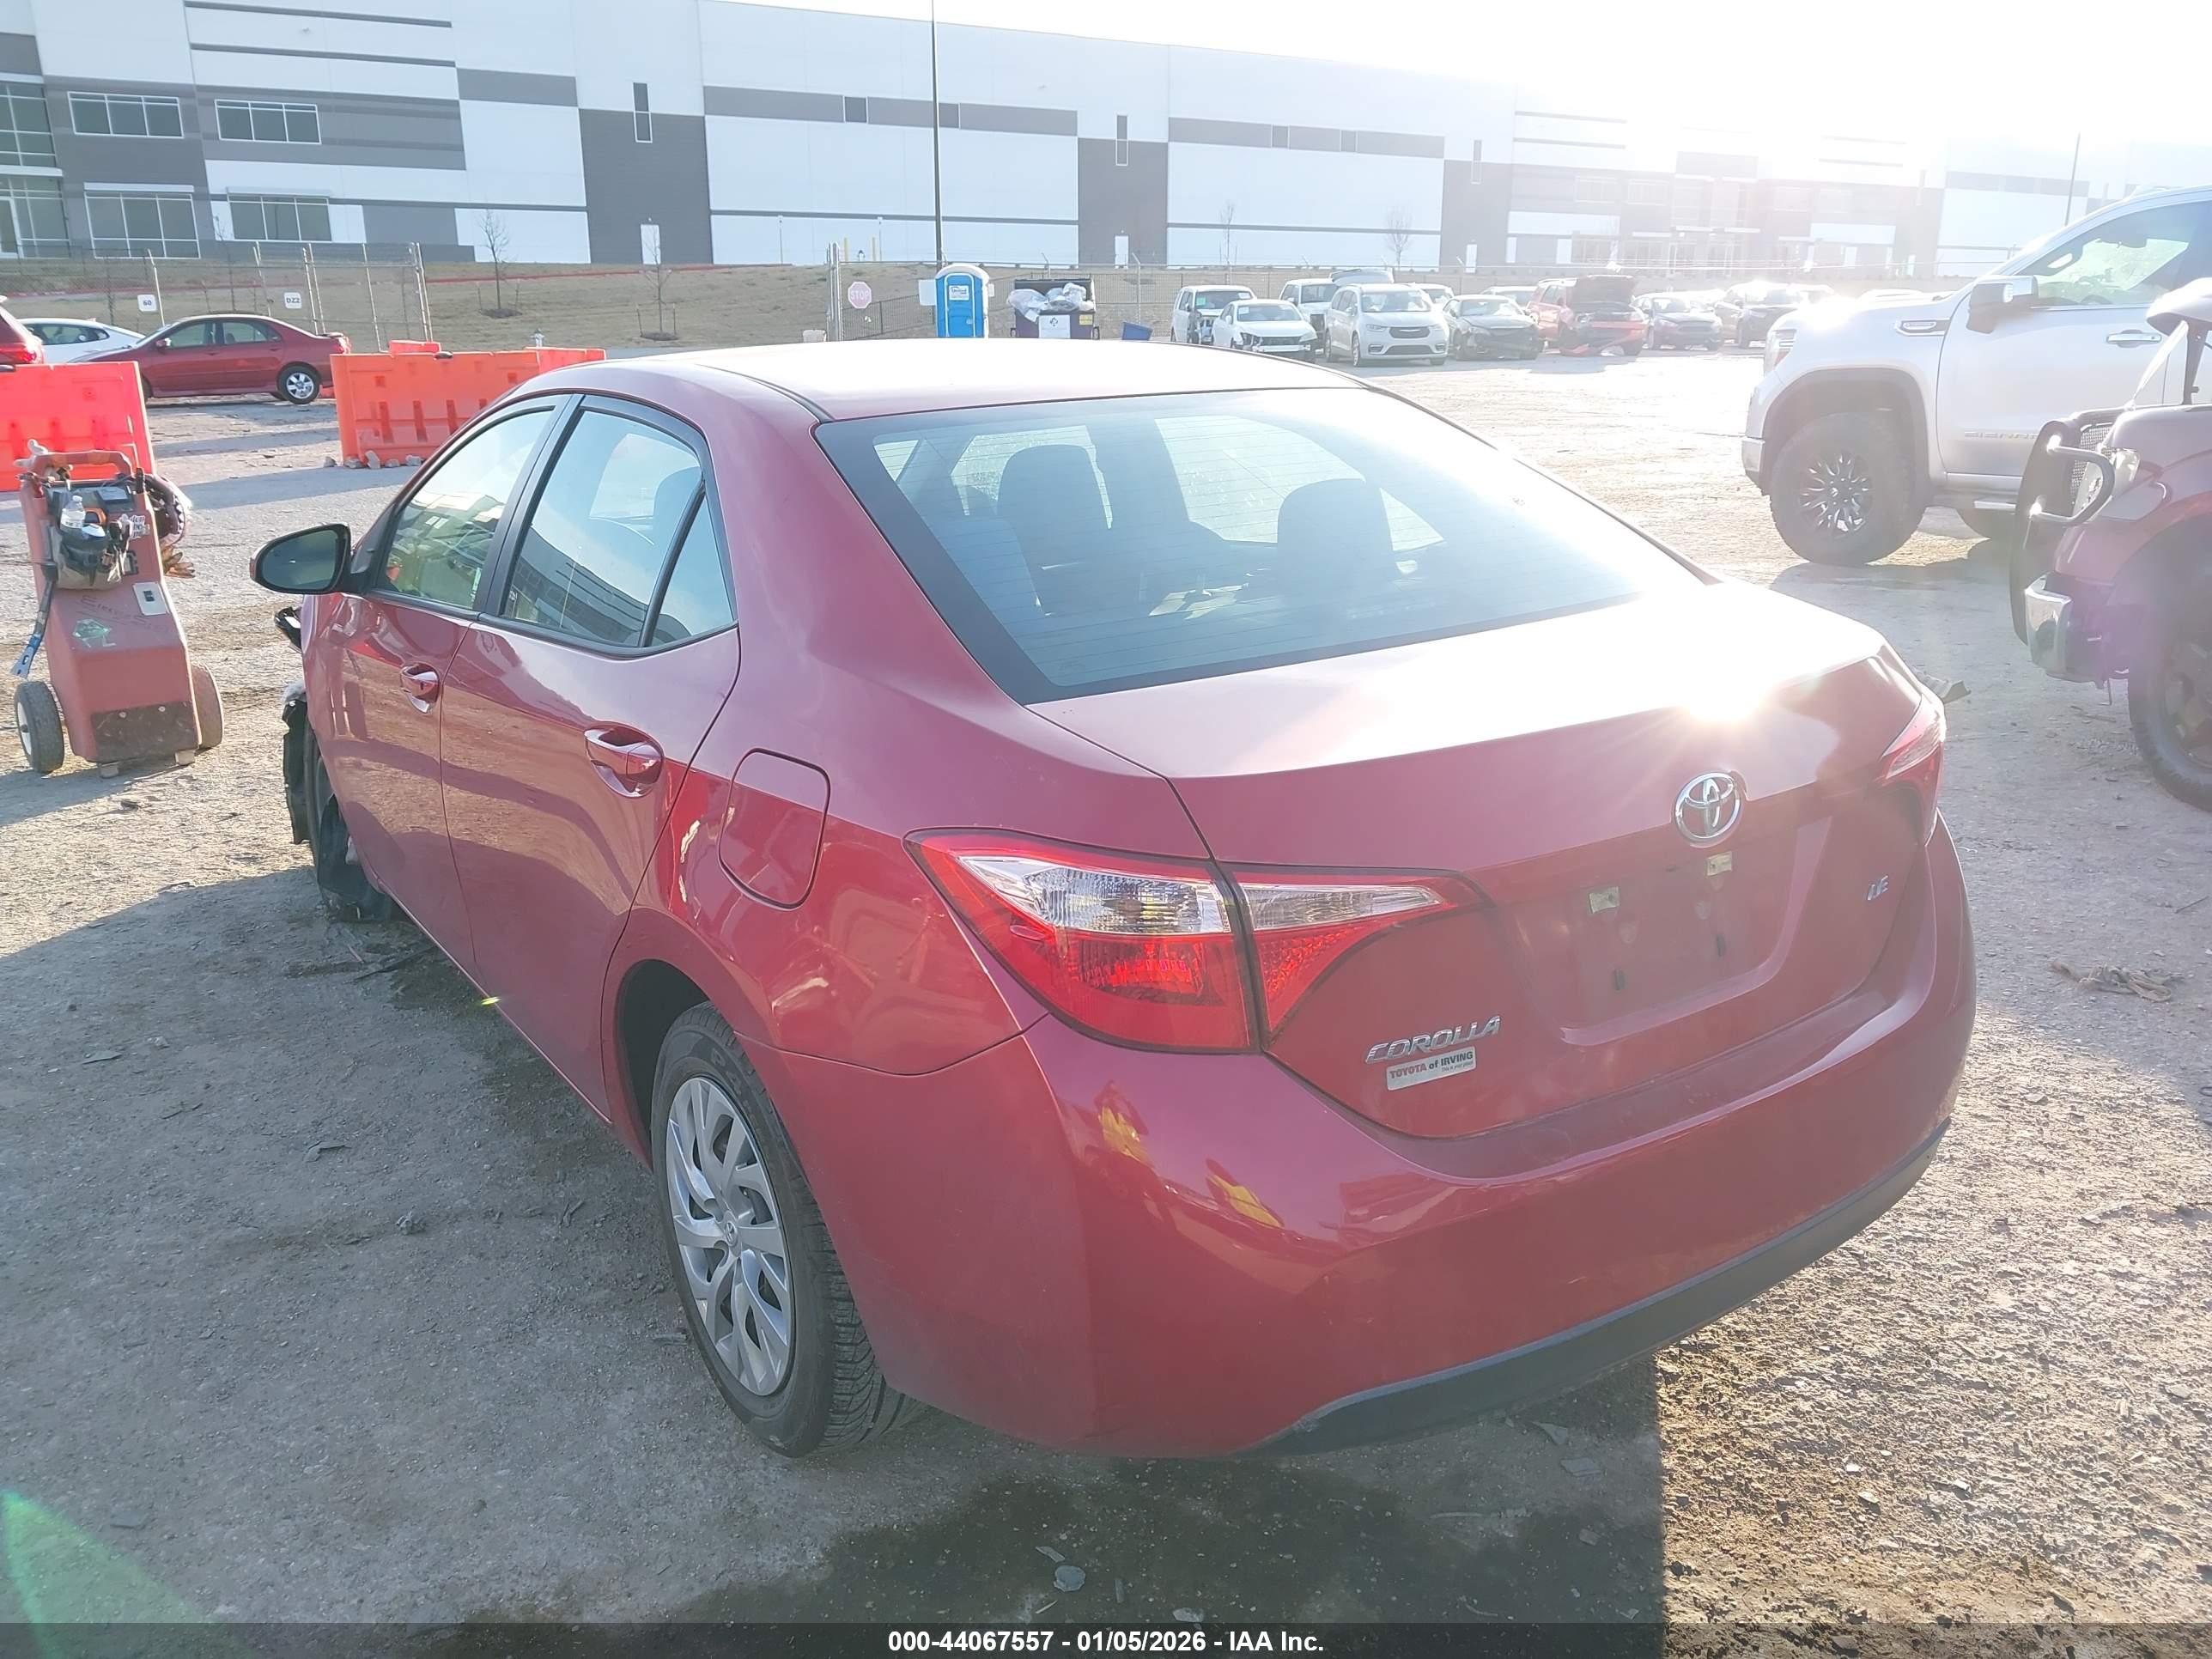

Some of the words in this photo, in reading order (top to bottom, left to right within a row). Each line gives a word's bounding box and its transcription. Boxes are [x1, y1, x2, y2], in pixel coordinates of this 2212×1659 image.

[851, 290, 870, 301] STOP
[1867, 874, 1888, 901] LE
[1365, 1015, 1501, 1065] COROLLA
[1389, 1063, 1427, 1079] TOYOTA
[1429, 1060, 1439, 1070] of
[1441, 1051, 1474, 1066] IRVING
